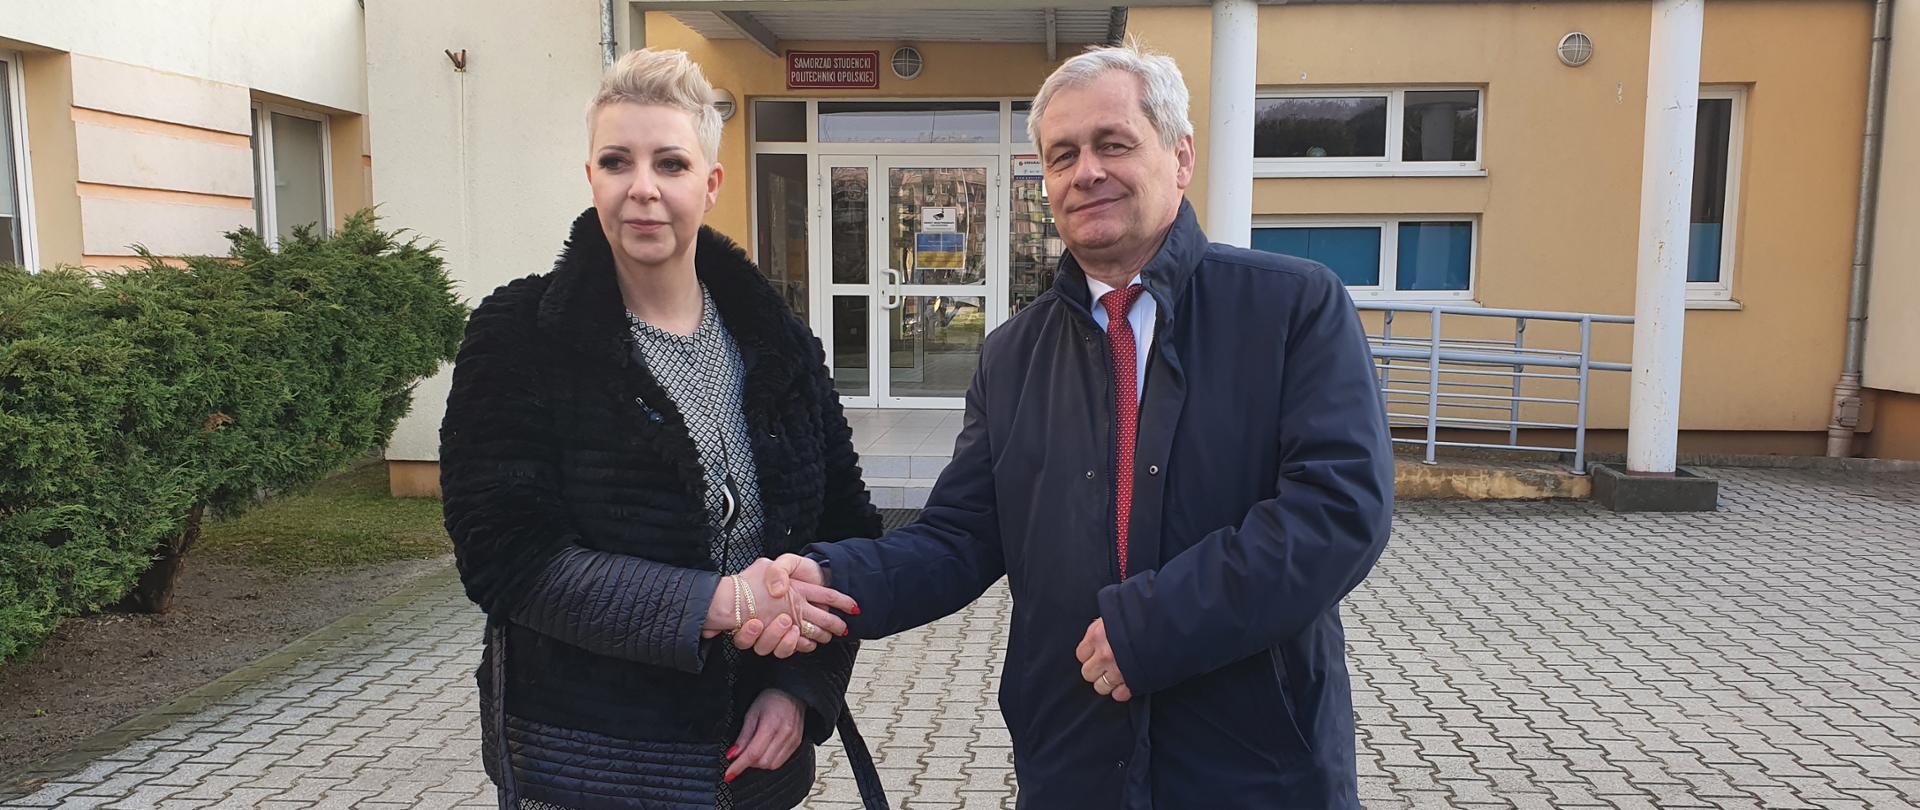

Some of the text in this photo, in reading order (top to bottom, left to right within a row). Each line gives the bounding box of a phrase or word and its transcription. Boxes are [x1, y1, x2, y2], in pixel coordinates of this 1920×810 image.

[833, 57, 871, 69] STUDENCKI
[791, 71, 874, 83] POLITECHNIKI OPOLSKIEJ
